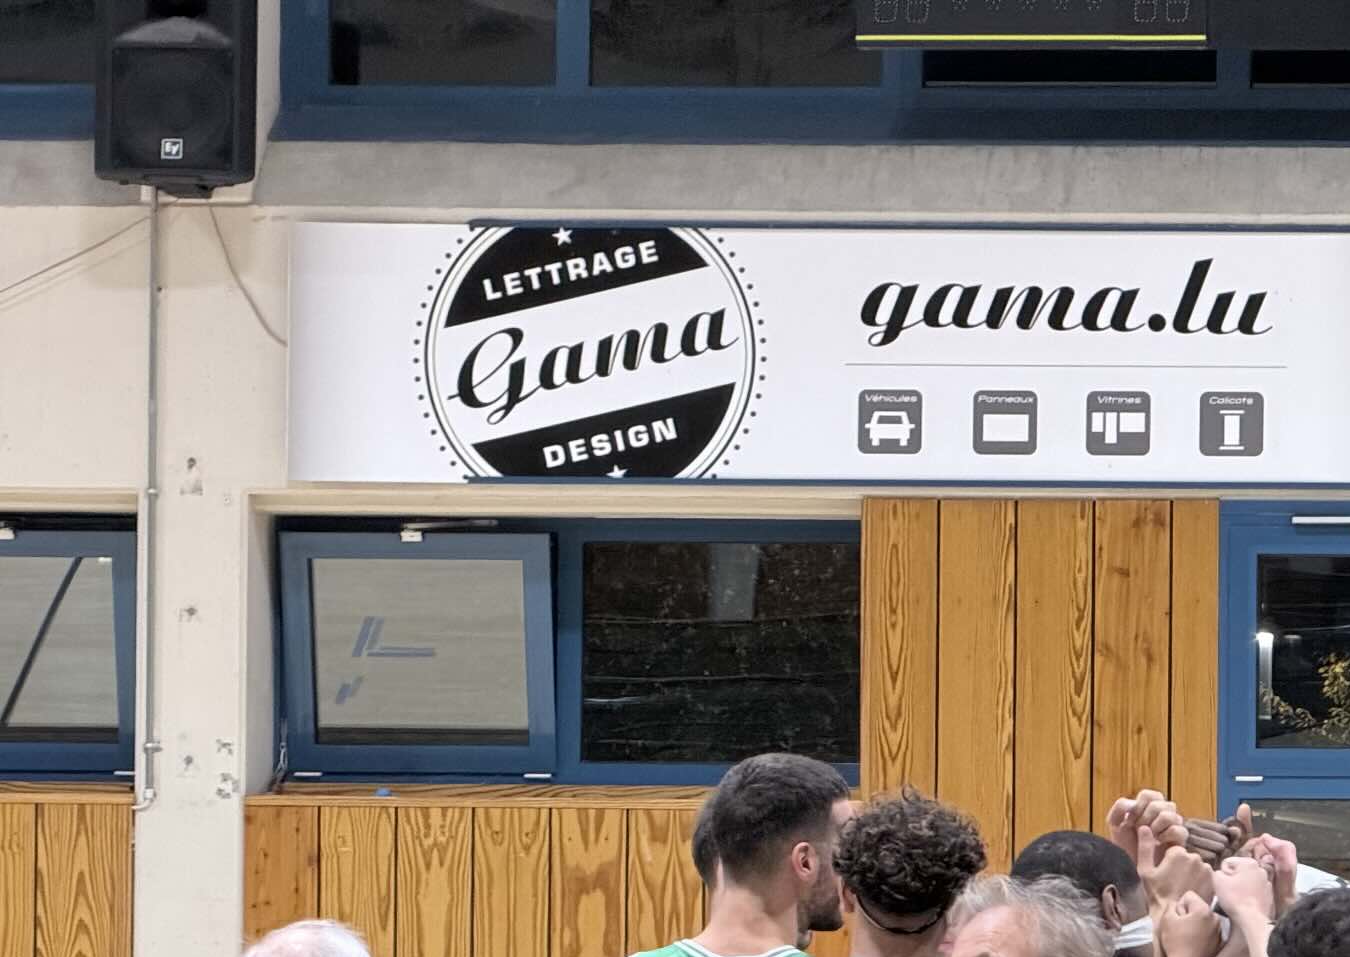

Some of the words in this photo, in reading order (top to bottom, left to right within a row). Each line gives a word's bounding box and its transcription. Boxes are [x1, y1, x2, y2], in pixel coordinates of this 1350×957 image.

[482, 240, 660, 302] LETTRAGE
[860, 257, 1273, 348] gama.lu
[447, 306, 740, 426] Gama
[864, 393, 918, 403] Véhicules
[977, 394, 1034, 404] Panneaux
[1097, 395, 1142, 405] Vitrines
[1208, 396, 1254, 405] Calicots
[542, 418, 678, 468] DESIGN
